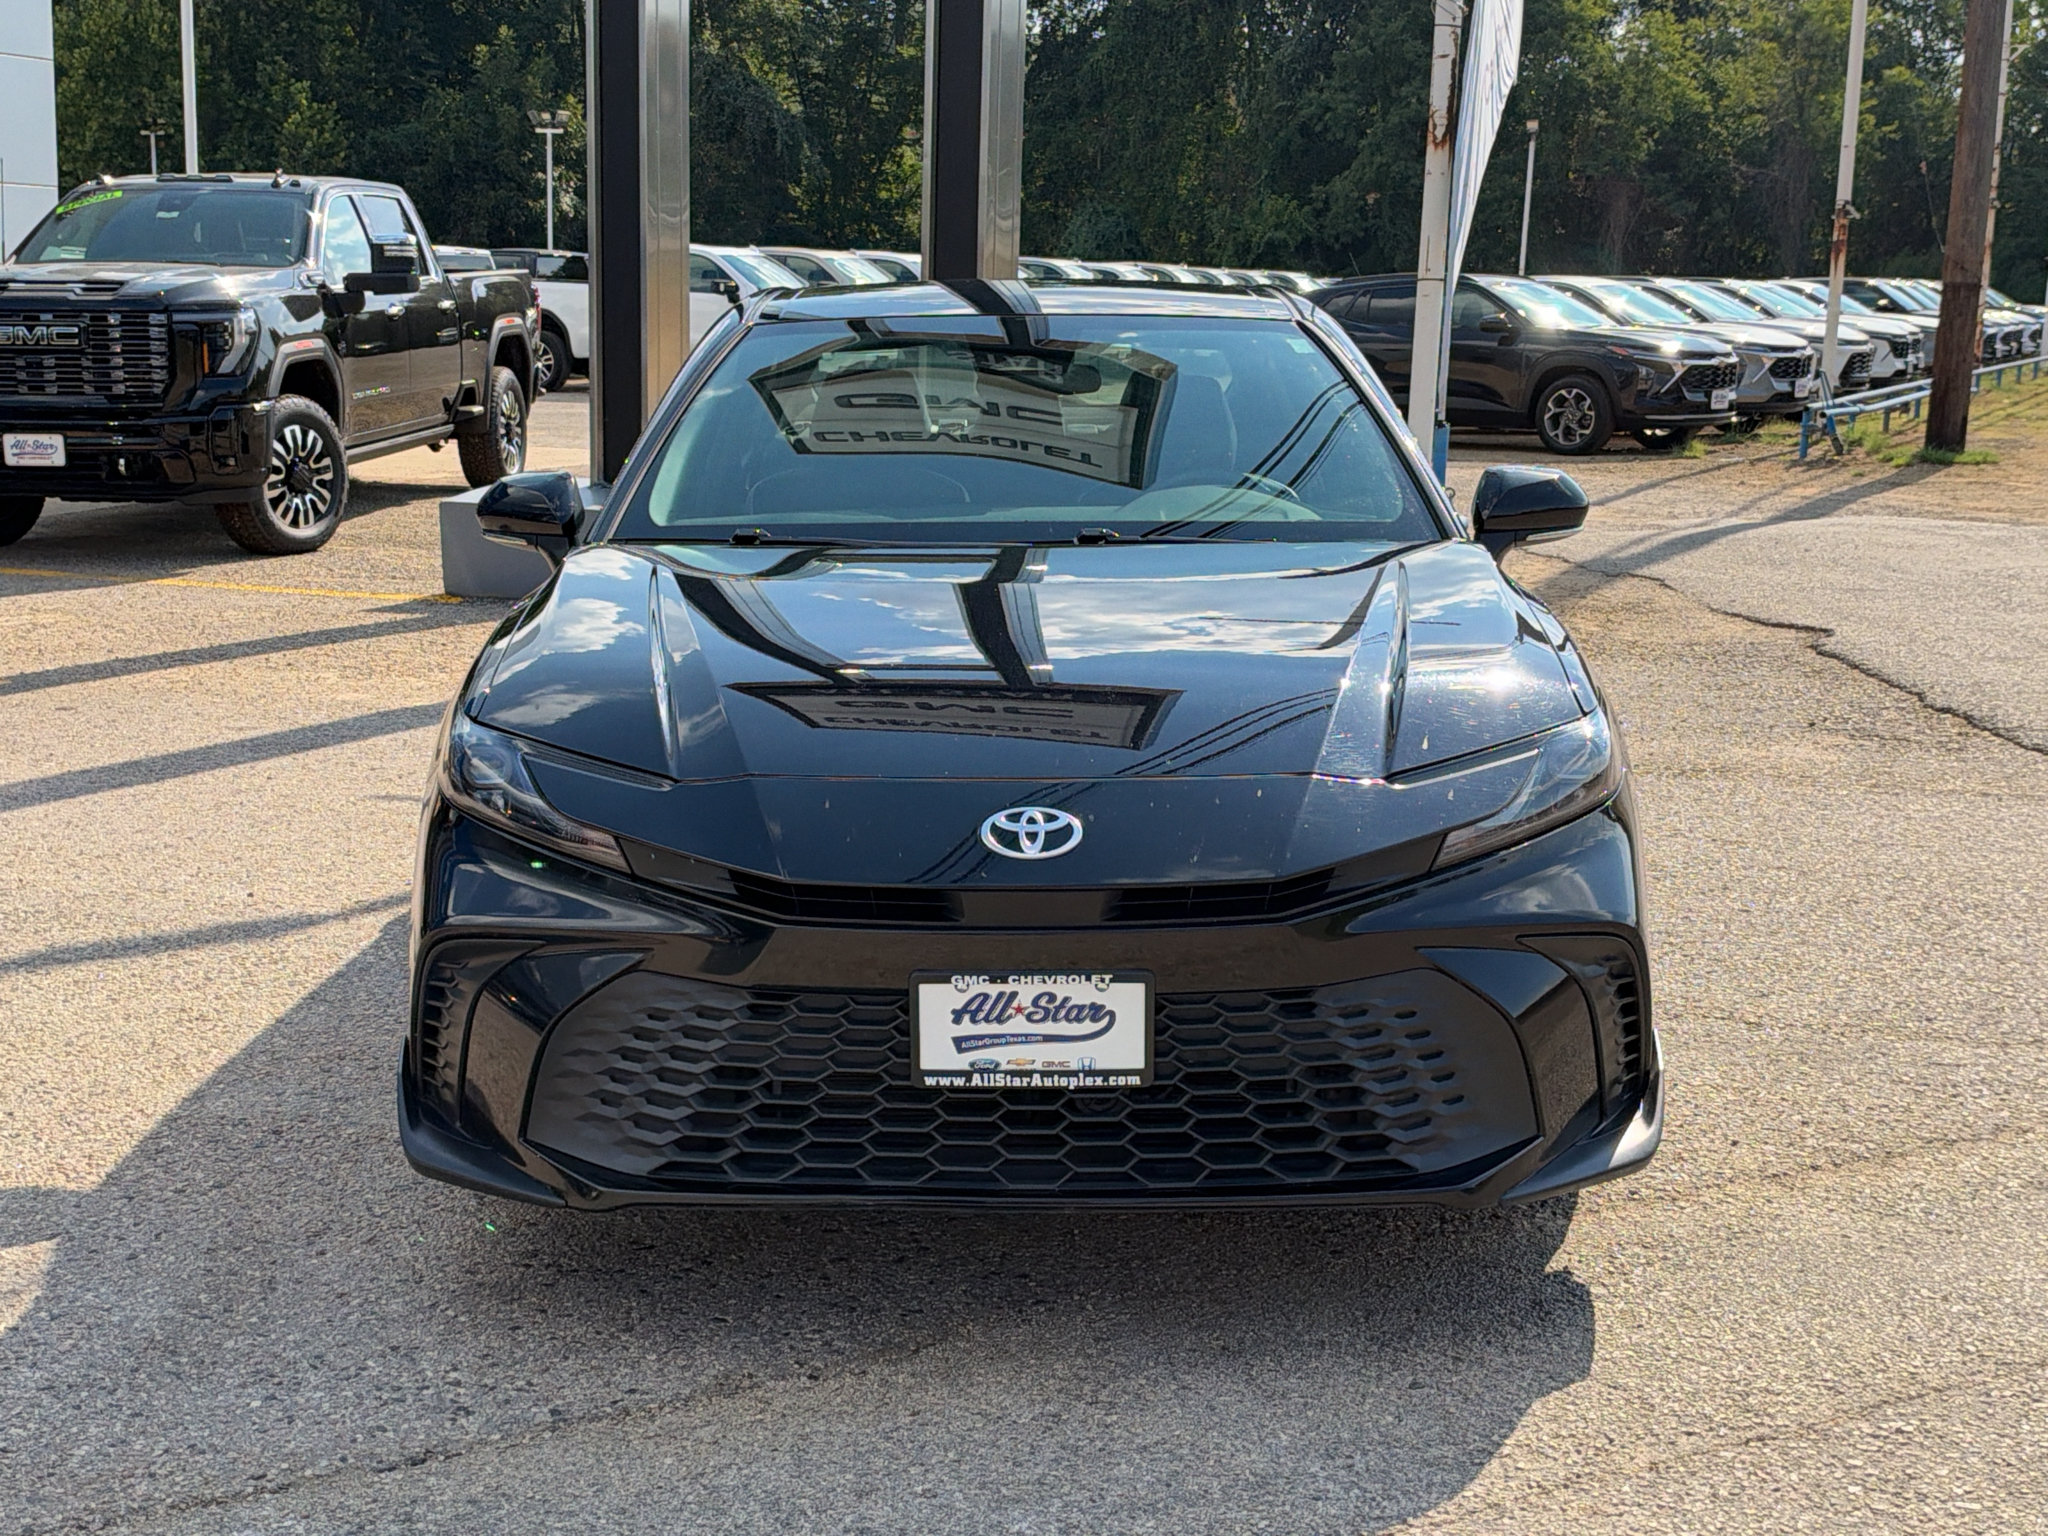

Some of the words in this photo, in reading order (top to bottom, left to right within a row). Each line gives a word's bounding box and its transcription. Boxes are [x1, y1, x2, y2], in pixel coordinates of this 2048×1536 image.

[951, 975, 990, 986] GMC
[1008, 974, 1114, 986] CHEVROLET
[951, 990, 1019, 1026] All
[1025, 991, 1108, 1025] Star
[961, 1034, 1043, 1050] AllStarGroupTexas.com
[1041, 1060, 1071, 1068] GMC
[924, 1073, 1142, 1090] www.AllStarAutoplex.com
